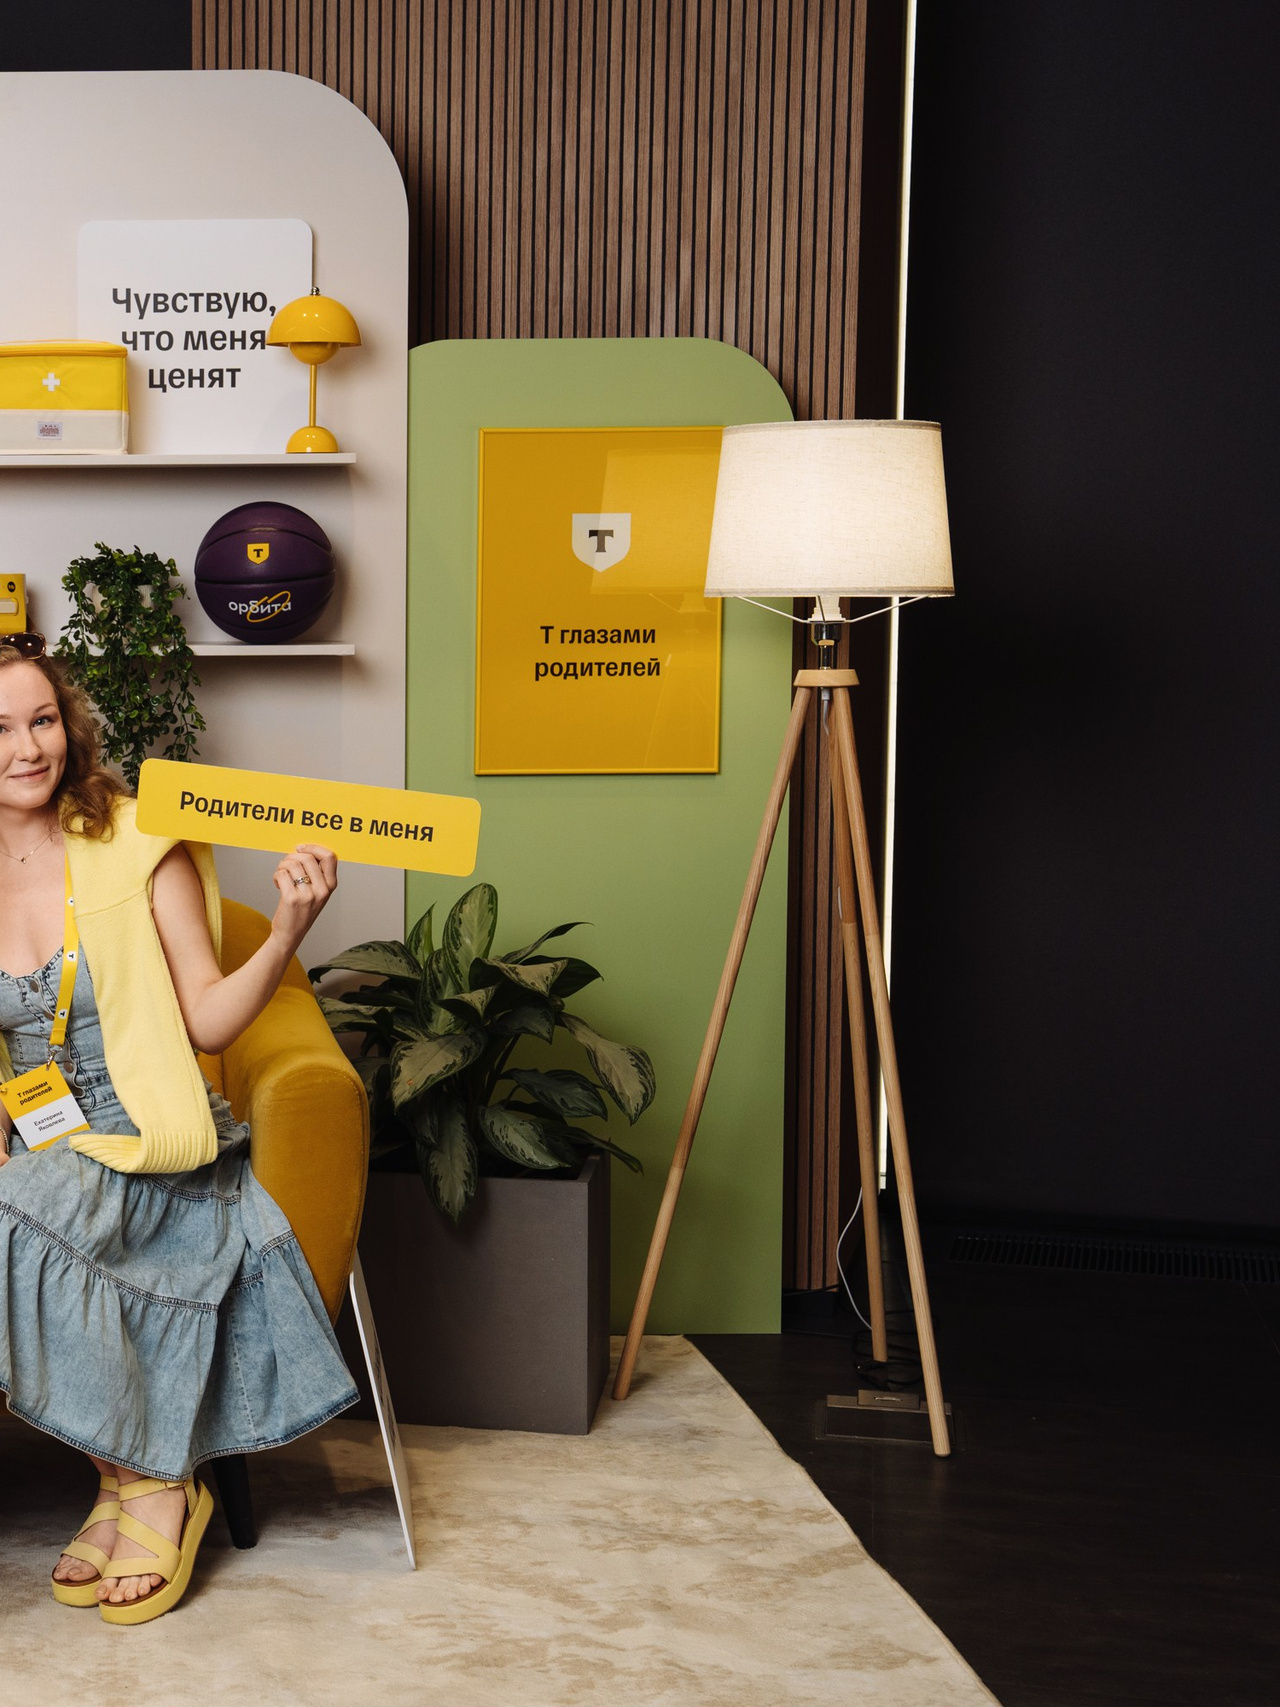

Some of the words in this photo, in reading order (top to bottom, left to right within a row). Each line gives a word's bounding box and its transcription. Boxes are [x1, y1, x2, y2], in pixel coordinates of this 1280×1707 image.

[111, 287, 277, 320] Чувствую,
[121, 330, 174, 351] что
[183, 329, 266, 351] меня
[147, 366, 242, 393] ценят
[588, 529, 614, 553] Т
[253, 548, 264, 558] Т
[228, 600, 292, 615] орбита
[540, 625, 555, 645] Т
[559, 626, 657, 645] глазами
[534, 657, 662, 682] родителей
[179, 790, 295, 825] Родители
[301, 810, 344, 831] все
[349, 817, 364, 833] в
[369, 819, 435, 843] меня
[19, 1086, 53, 1106] родителей
[22, 1081, 49, 1097] глазами
[34, 1110, 64, 1127] Екатерина
